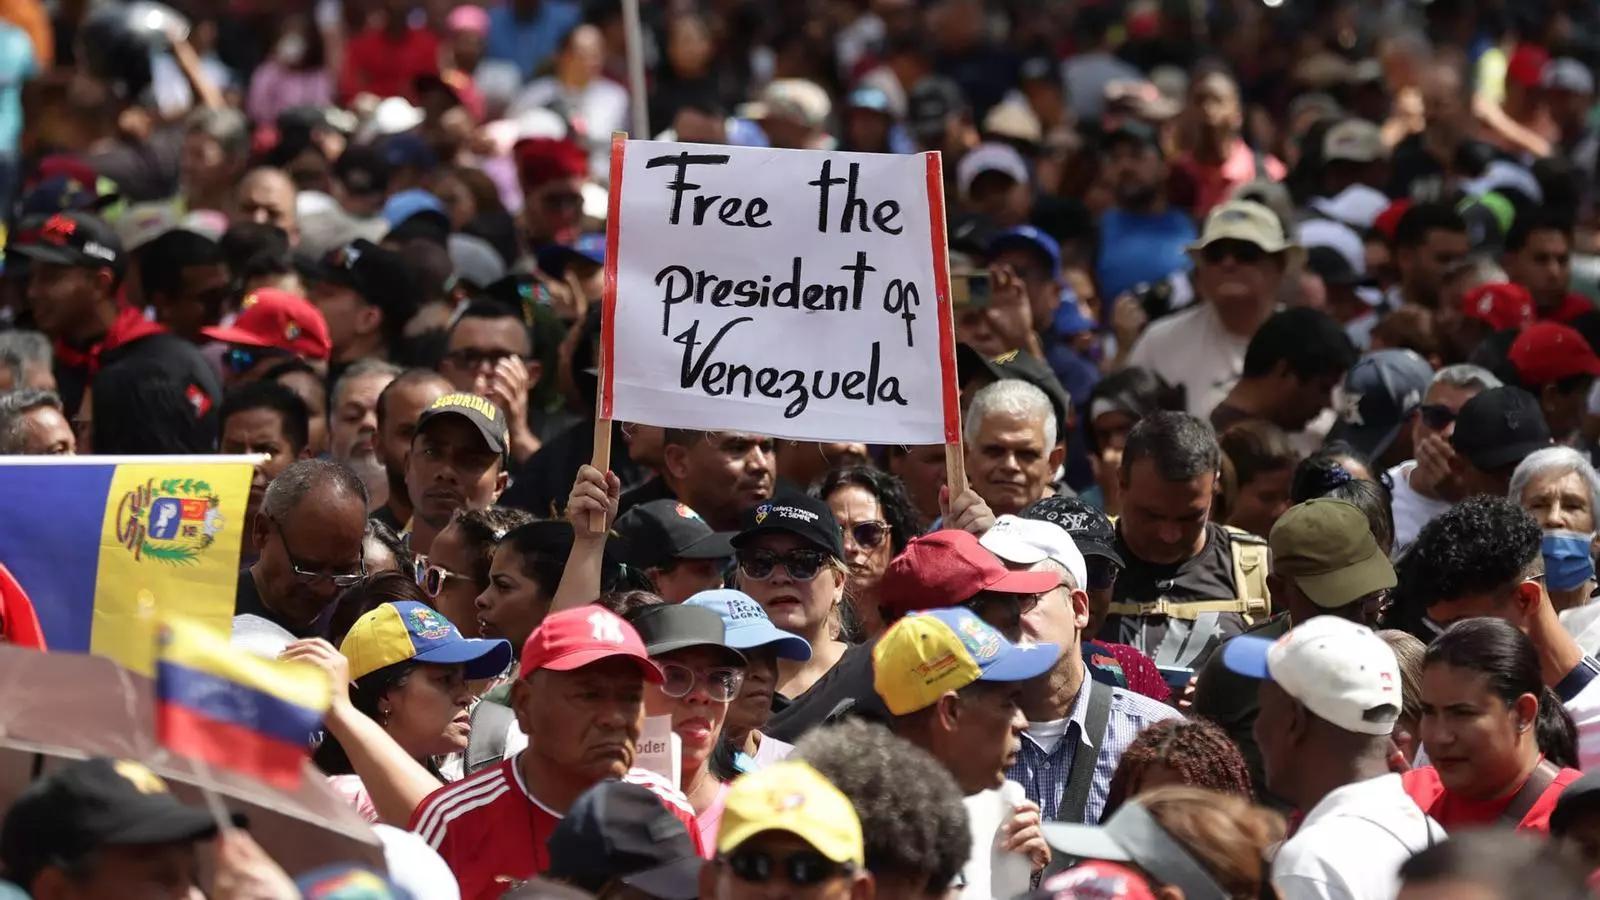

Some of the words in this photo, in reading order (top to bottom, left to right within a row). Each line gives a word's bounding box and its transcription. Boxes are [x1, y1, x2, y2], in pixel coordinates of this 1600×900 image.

[646, 151, 773, 228] Free
[807, 159, 904, 235] the
[655, 251, 878, 336] president
[883, 278, 921, 347] of
[431, 393, 496, 421] SEGURIDAD
[673, 317, 908, 418] Venezuela
